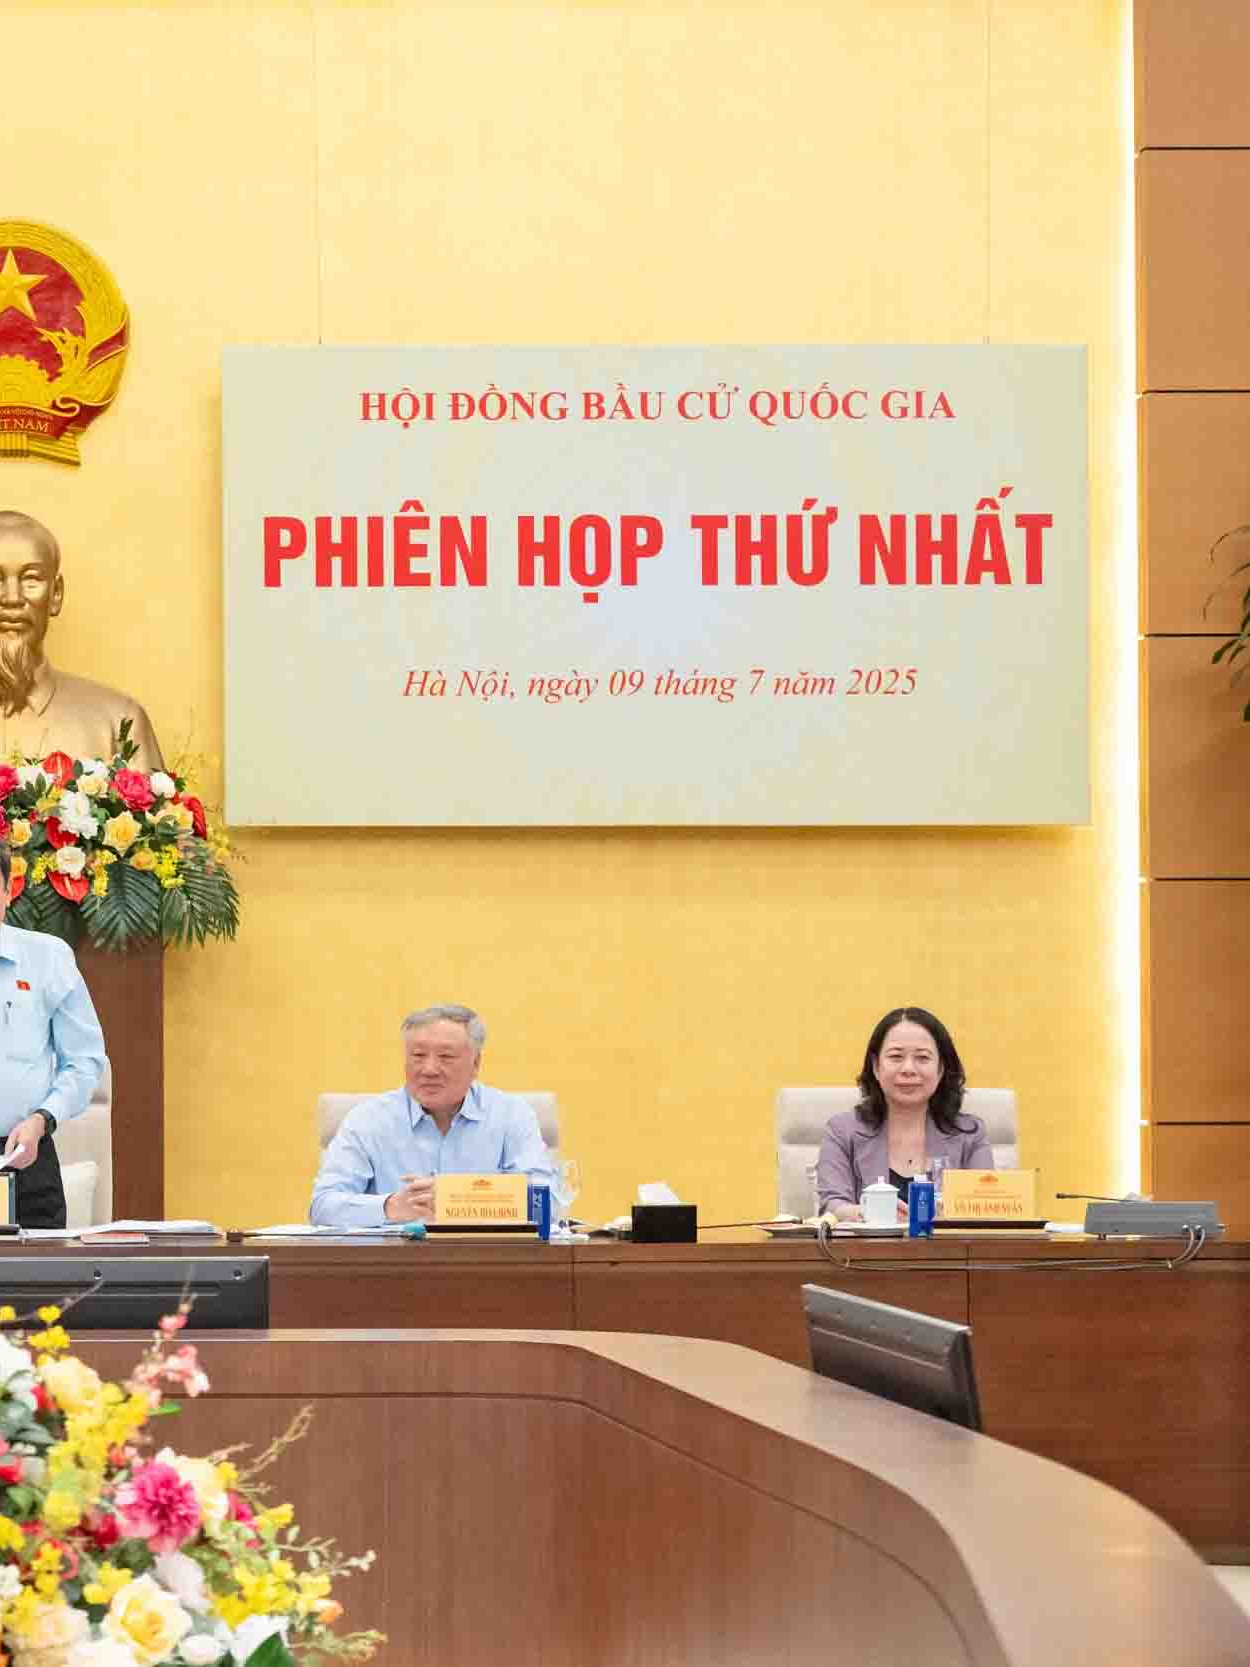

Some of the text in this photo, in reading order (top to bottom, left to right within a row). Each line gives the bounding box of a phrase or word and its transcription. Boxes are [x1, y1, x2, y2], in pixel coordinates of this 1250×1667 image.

[13, 417, 48, 433] NAM
[359, 382, 958, 430] HỘI ĐỒNG BẦU CỬ QUỐC GIA
[263, 485, 1055, 604] PHIÊN HỌP THỨ NHẤT
[402, 667, 919, 704] Hà Nội, ngày 09 tháng 7 năm 2025
